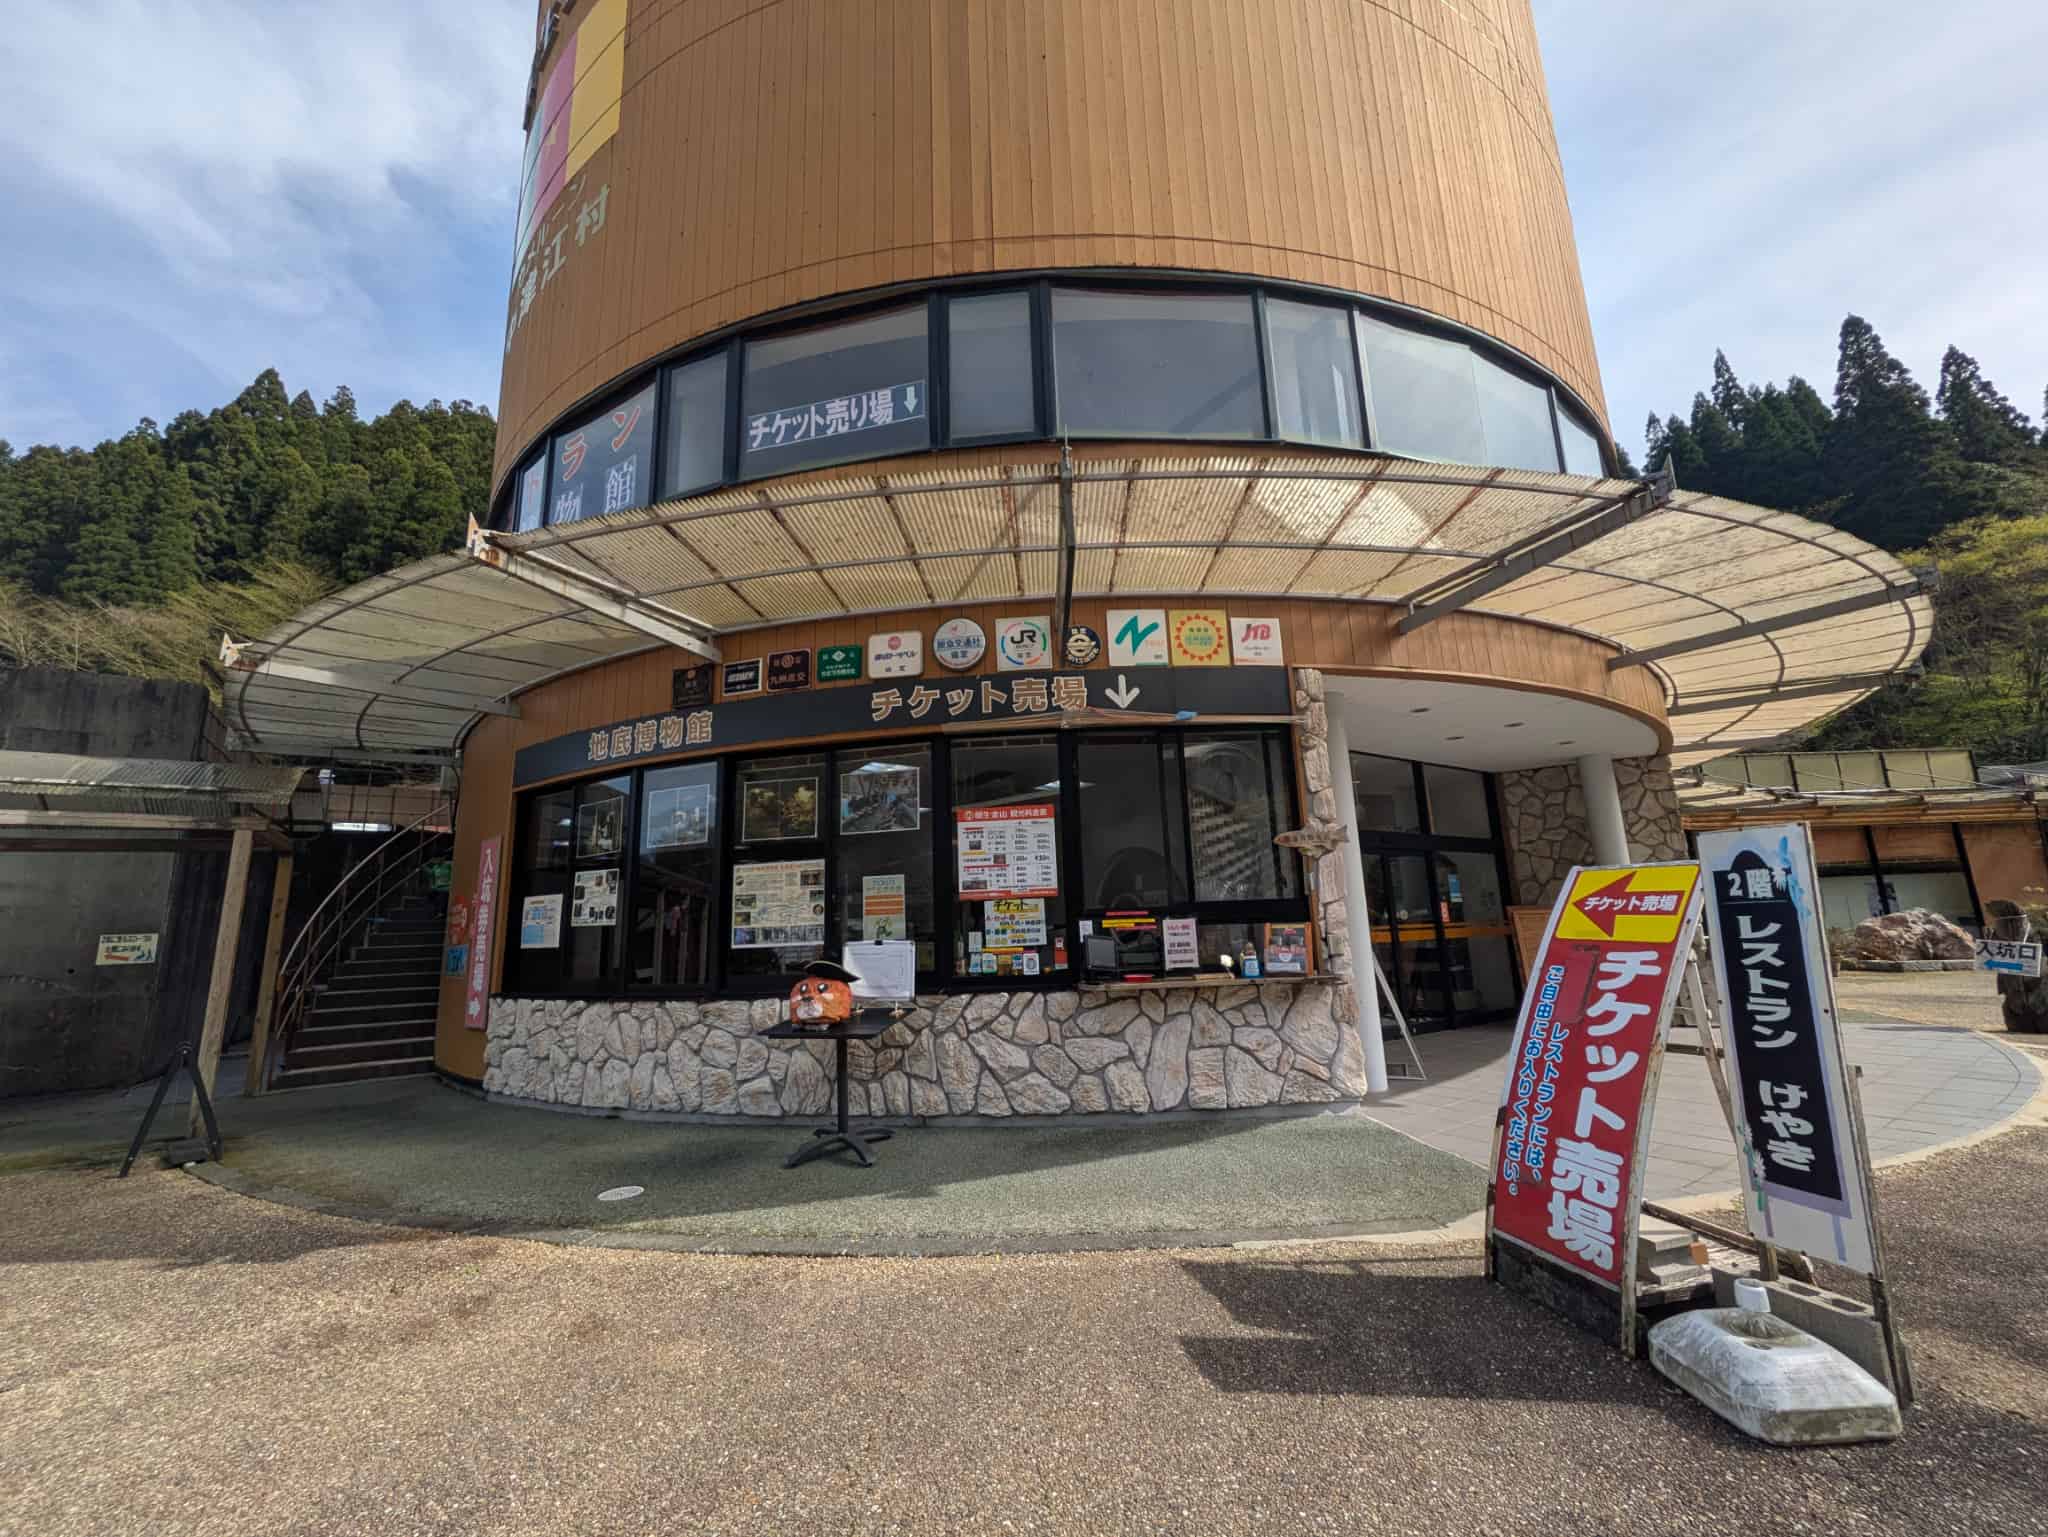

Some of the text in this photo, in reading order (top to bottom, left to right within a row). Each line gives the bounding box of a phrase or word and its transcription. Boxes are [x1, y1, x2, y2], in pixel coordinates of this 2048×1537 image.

[750, 389, 894, 449] チケット売り場
[1010, 630, 1036, 645] JR
[1241, 624, 1271, 643] JTB
[871, 676, 1088, 722] チケット売場
[588, 710, 713, 761] 地底博物館
[1584, 895, 1678, 912] チケット売場
[1727, 867, 1775, 899] 2階
[1975, 942, 2036, 960] 入坑口
[1735, 914, 1817, 1173] レストラン けやき
[1503, 964, 1565, 1197] ご自由にお入りください。
[1525, 1021, 1569, 1183] レストランには、
[1547, 950, 1662, 1270] チケット売場
